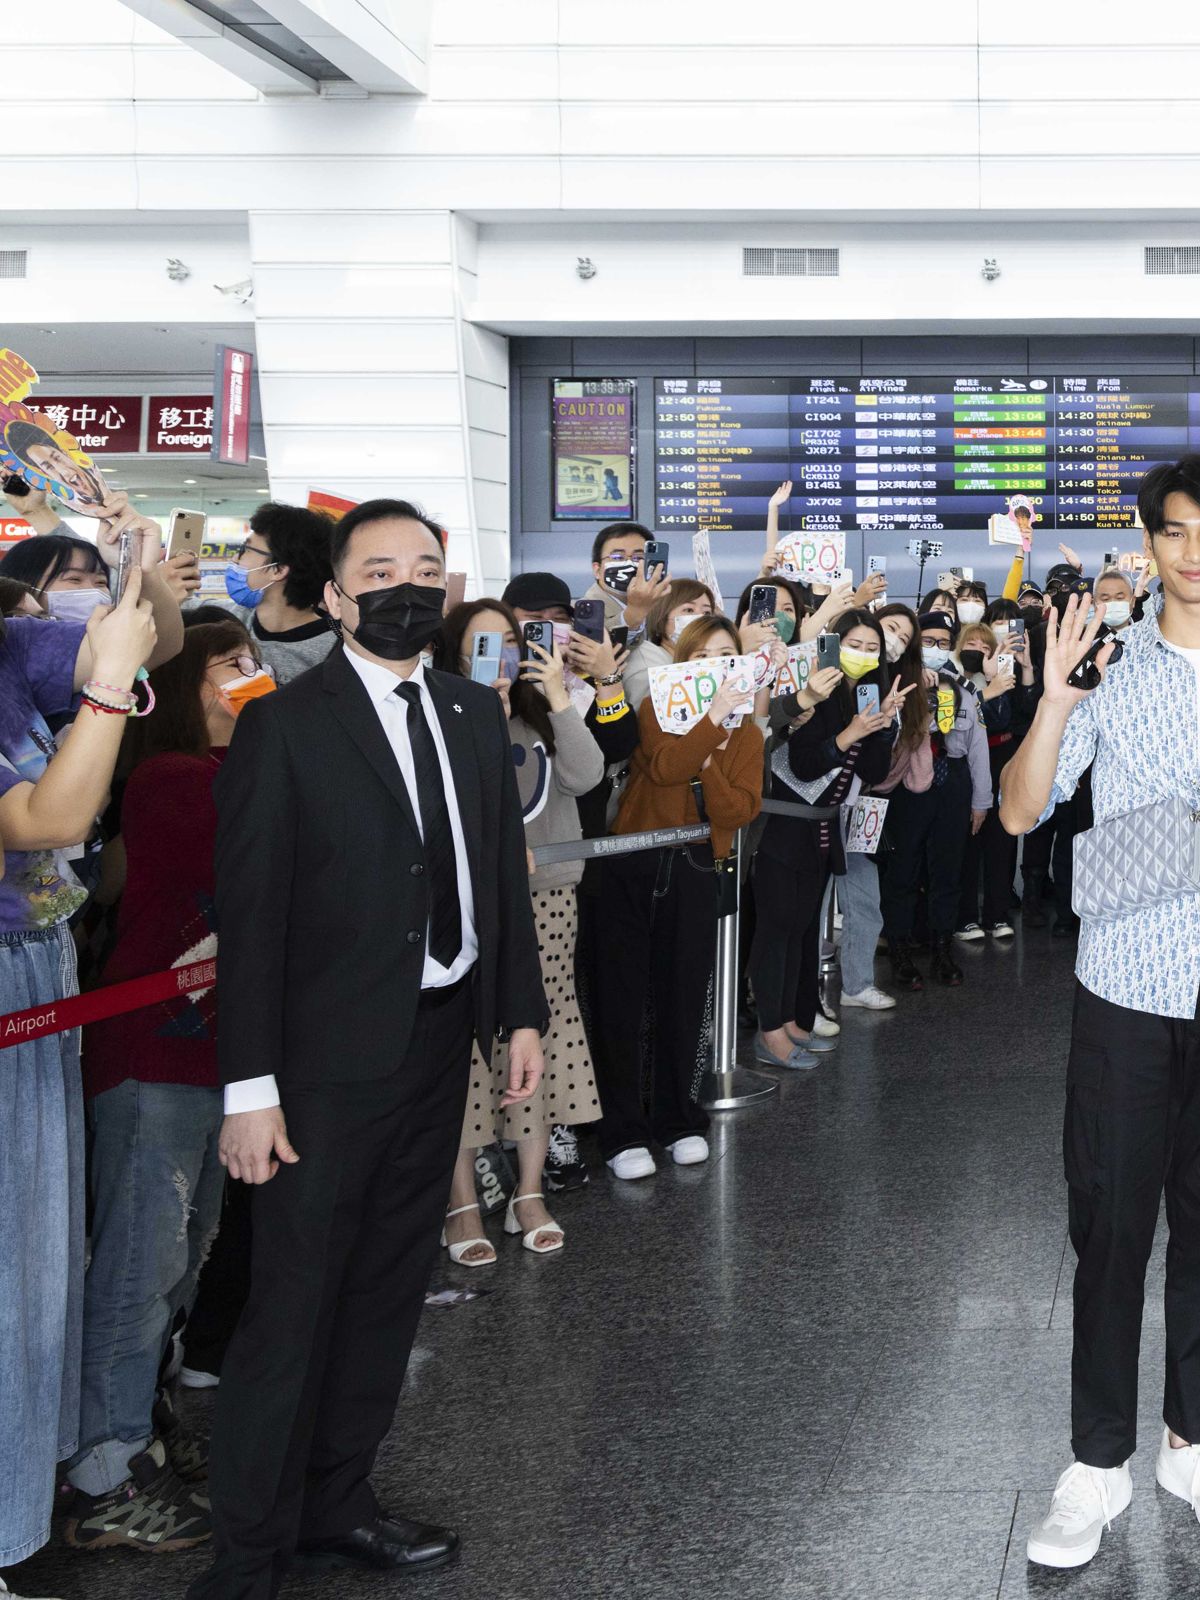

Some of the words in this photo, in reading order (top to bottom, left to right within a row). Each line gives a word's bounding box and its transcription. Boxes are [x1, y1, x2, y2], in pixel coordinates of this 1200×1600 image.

[806, 396, 840, 404] IT241
[1004, 395, 1044, 404] 13:05
[559, 404, 624, 415] CAUTION
[805, 413, 841, 421] CI904
[1005, 412, 1042, 420] 13:04
[659, 430, 695, 438] 12:55
[1005, 428, 1044, 437] 13:44
[77, 434, 109, 448] nter
[158, 432, 213, 448] Foreign
[659, 447, 695, 455] 13:30
[1005, 445, 1042, 453] 13:38
[1004, 463, 1044, 472] 13:24
[806, 481, 841, 489] BI451
[1005, 480, 1042, 488] 13:36
[780, 544, 840, 574] APO
[653, 832, 676, 843] Taiwan
[677, 827, 702, 840] Taoyuan
[5, 1010, 57, 1036] Airport
